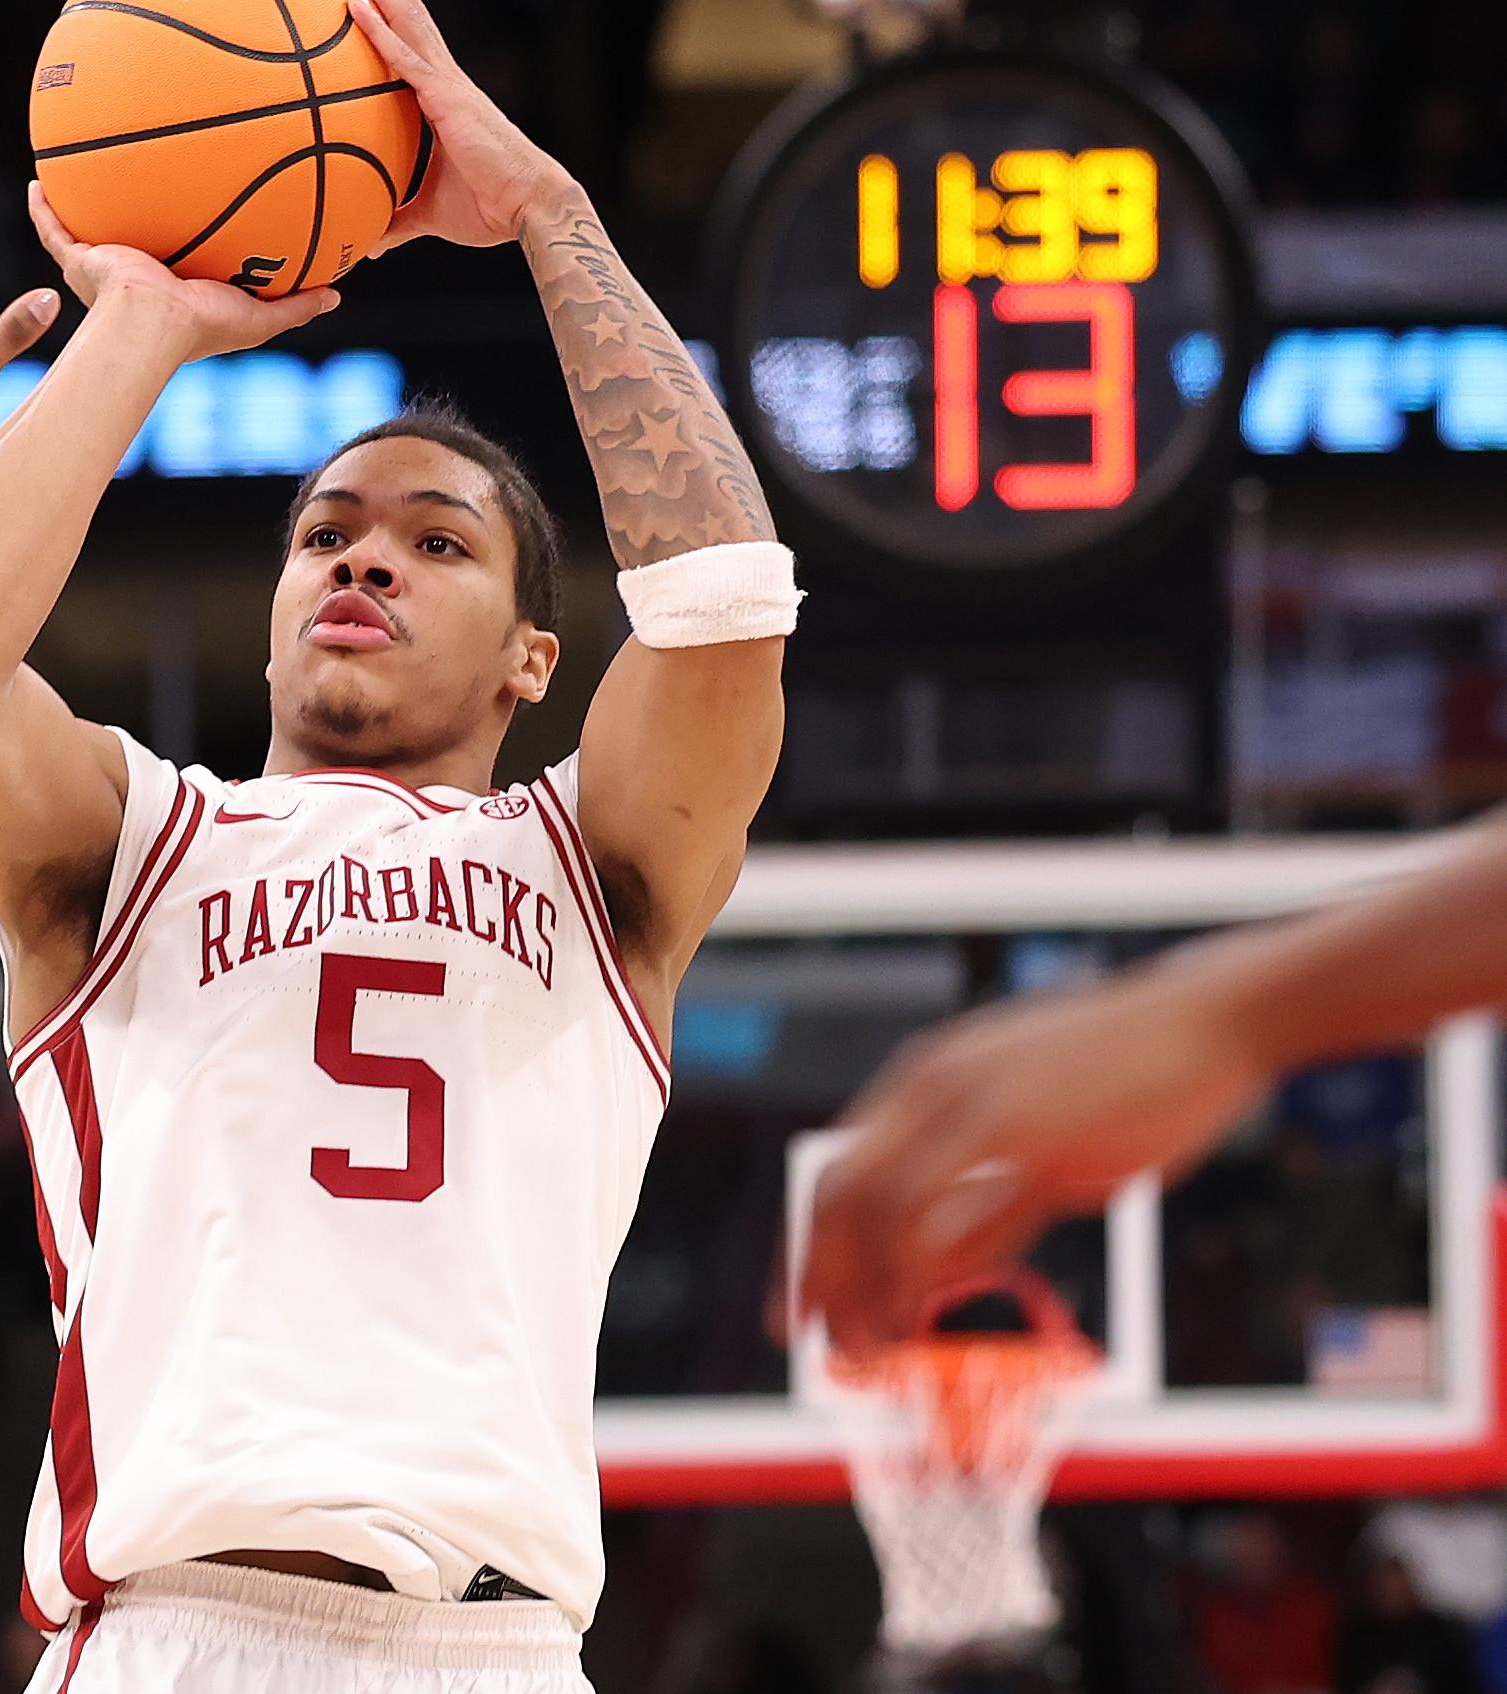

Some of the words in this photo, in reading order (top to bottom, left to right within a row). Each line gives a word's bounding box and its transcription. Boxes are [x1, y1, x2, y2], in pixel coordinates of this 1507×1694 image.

[858, 148, 1160, 288] 11:39
[934, 283, 1136, 512] 13
[481, 797, 529, 819] SEC
[198, 854, 557, 991] RAZORBACKS
[310, 952, 447, 1202] 5
